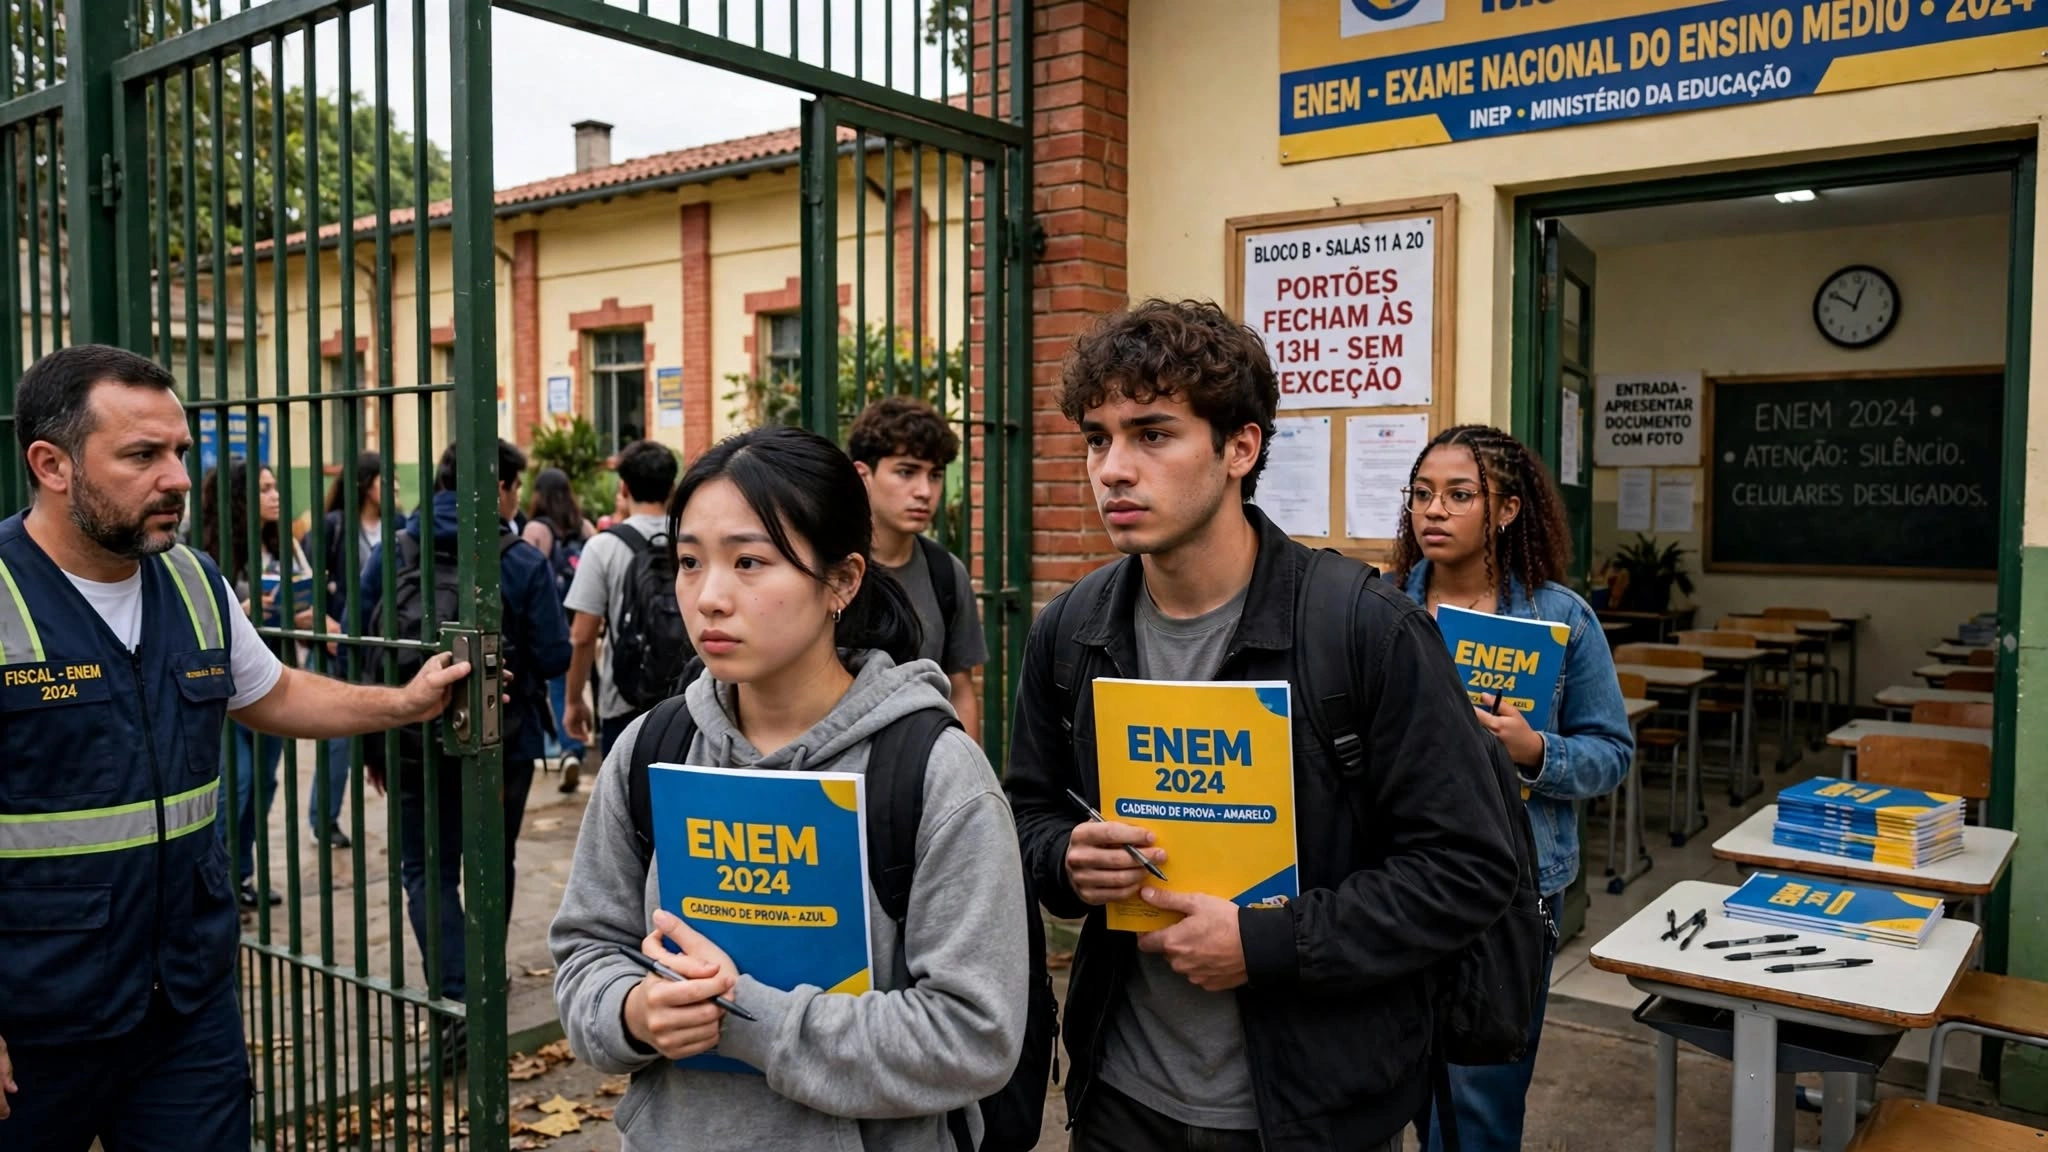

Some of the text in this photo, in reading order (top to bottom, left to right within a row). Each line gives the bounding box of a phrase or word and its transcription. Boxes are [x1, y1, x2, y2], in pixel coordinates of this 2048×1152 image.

[1293, 77, 1361, 119] ENEM
[1385, 59, 1475, 105] EXAME
[1482, 36, 1622, 100] NACIONAL
[1630, 27, 1670, 70] DO
[1679, 8, 1793, 64] ENSINO
[1469, 105, 1512, 129] INEP
[1530, 87, 1640, 121] MINISTÉRIO
[1645, 83, 1673, 106] DA
[1677, 63, 1792, 101] EDUCAÇÃO
[1254, 243, 1298, 263] BLOCO
[1302, 242, 1311, 259] B
[1326, 236, 1370, 256] SALAS
[1375, 235, 1387, 252] 11
[1392, 233, 1401, 251] A
[1406, 231, 1424, 250] 20
[1277, 265, 1398, 302] PORTÕES
[1263, 295, 1414, 334] FECHAM ÀS
[1275, 339, 1319, 363] 13H
[1347, 334, 1403, 360] SEM
[1280, 361, 1401, 399] EXCEÇÃO
[1616, 381, 1679, 397] ENTRADA
[1604, 398, 1693, 413] APRESENTAR
[1755, 400, 1832, 431] ENEM
[1849, 397, 1919, 428] 2024
[1605, 415, 1692, 430] DOCUMENTO
[1612, 432, 1683, 446] COM FOTO
[1744, 439, 1849, 472] ATENÇÃO:
[1732, 483, 1989, 507] CELULARES DESLIGADOS.
[1454, 639, 1540, 676] ENEM
[5, 667, 56, 686] FISCAL
[65, 664, 102, 680] ENEM
[1468, 670, 1517, 691] 2024
[41, 683, 78, 700] 2024
[1127, 725, 1253, 767] ENEM
[1155, 768, 1225, 794] 2024
[1121, 803, 1166, 816] CADERNO
[1169, 806, 1181, 817] DE
[1183, 807, 1215, 819] PROVA
[1224, 809, 1271, 820] AMARELO
[686, 817, 819, 866] ENEM
[716, 865, 791, 895] 2024
[690, 902, 737, 918] CADERNO
[739, 908, 754, 919] DE
[754, 910, 790, 921] PROVA
[799, 912, 826, 922] AZUL
